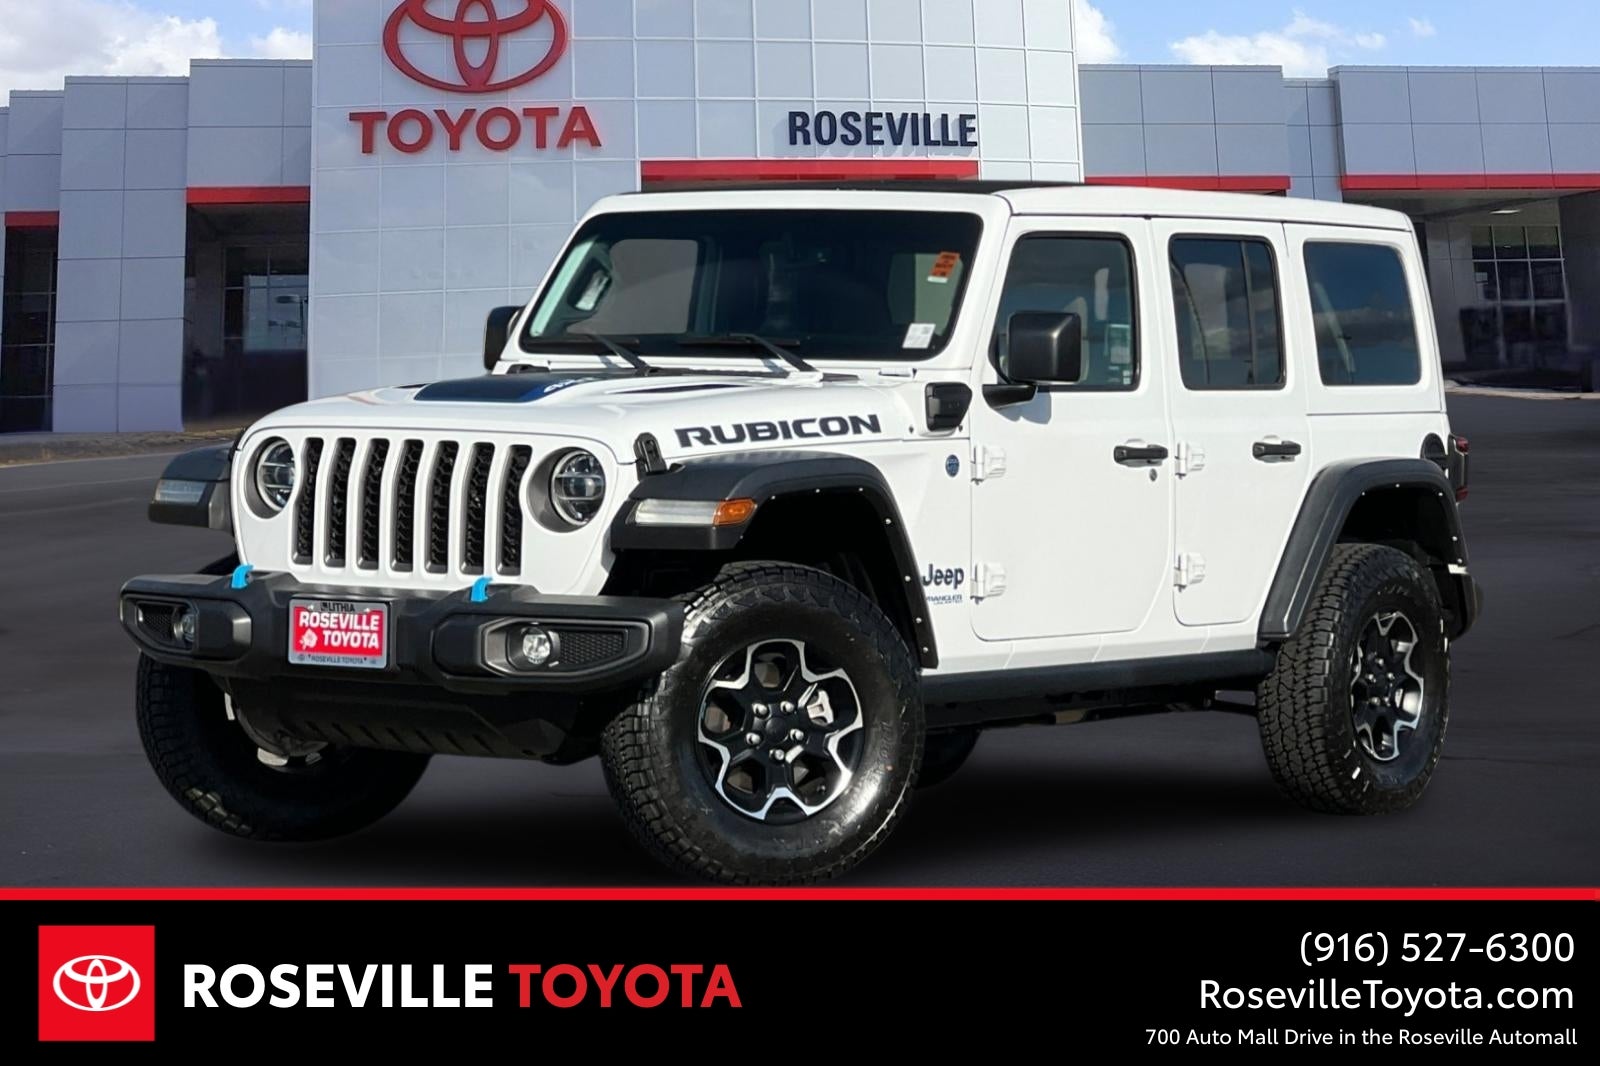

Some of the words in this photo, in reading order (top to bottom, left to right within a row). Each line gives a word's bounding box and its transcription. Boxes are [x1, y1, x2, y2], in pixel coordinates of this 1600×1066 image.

[349, 106, 601, 154] TOYOTA
[788, 110, 978, 147] ROSEVILLE
[674, 414, 882, 448] RUBICON
[922, 563, 964, 590] Jeep
[299, 611, 380, 631] ROSEVILLE
[322, 630, 379, 649] TOYOTA
